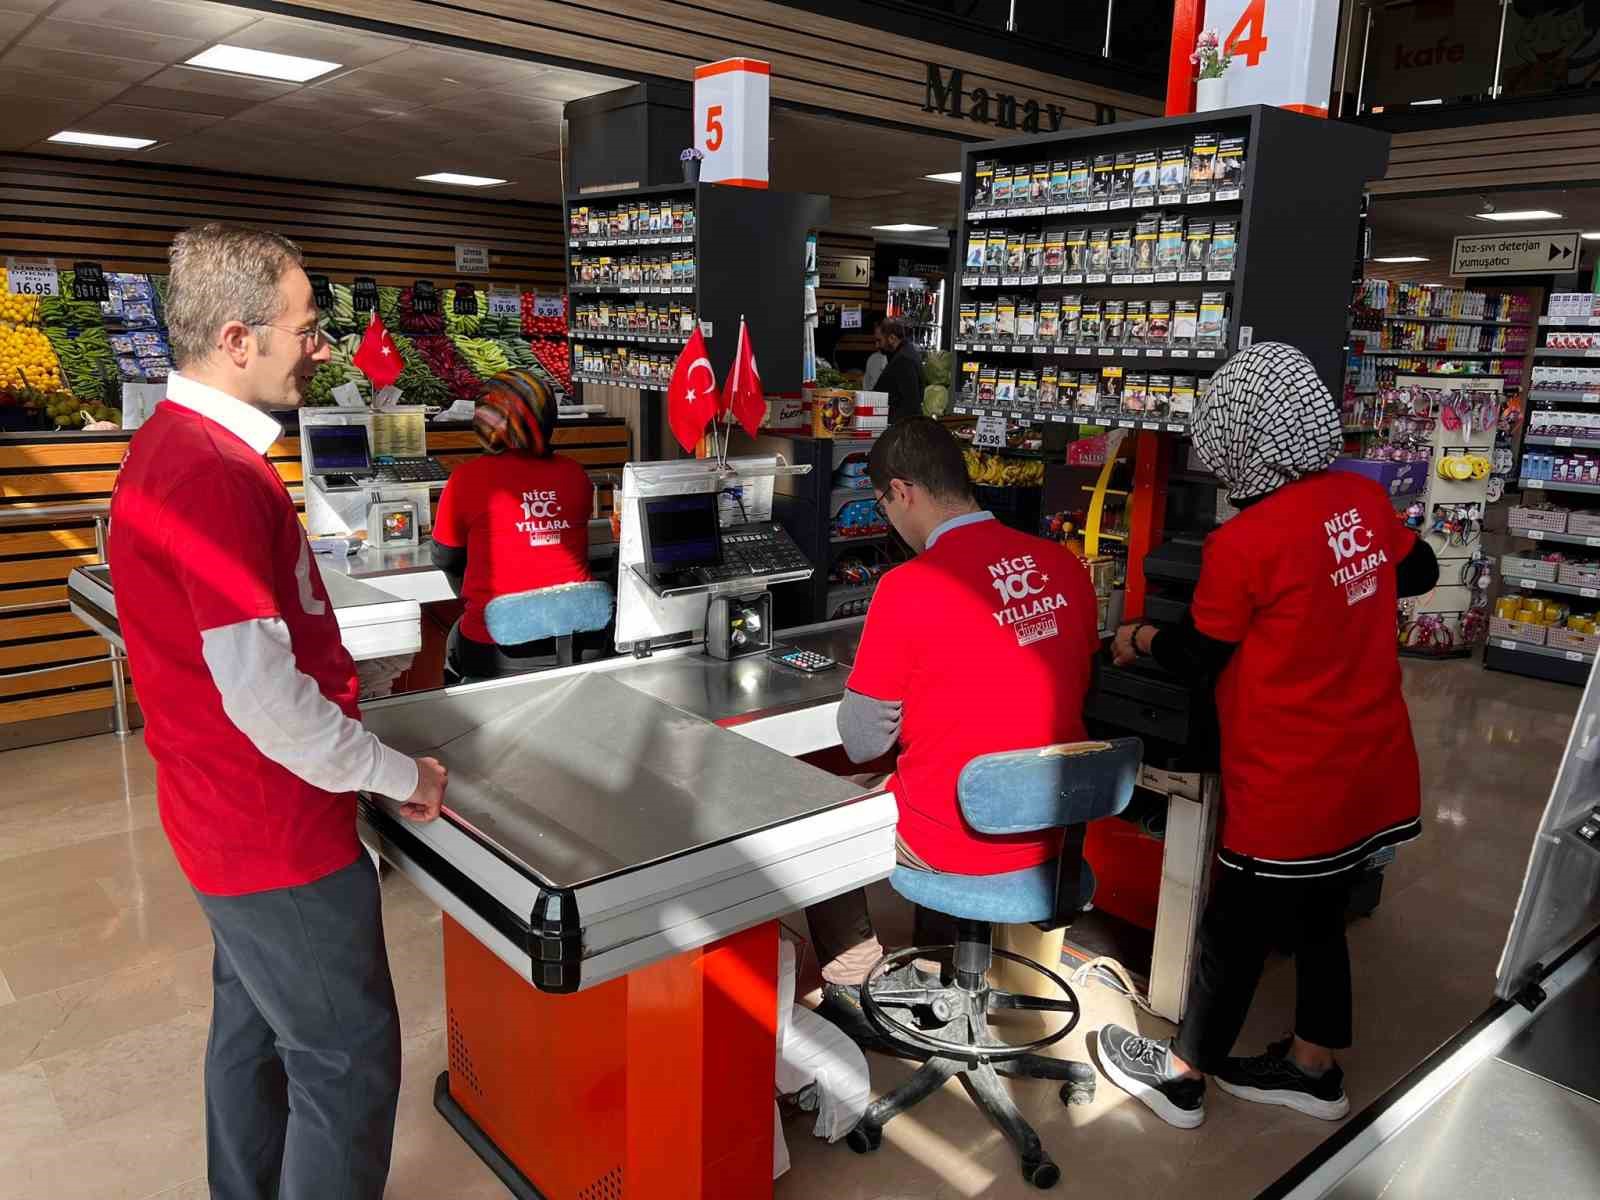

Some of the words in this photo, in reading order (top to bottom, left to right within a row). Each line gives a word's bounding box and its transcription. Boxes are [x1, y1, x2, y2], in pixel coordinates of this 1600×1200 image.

[1223, 0, 1268, 67] 4
[705, 105, 723, 151] 5
[1498, 241, 1541, 253] deterjan
[16, 282, 51, 296] 16.95
[493, 303, 516, 313] 19.95
[538, 307, 559, 316] 9.95
[978, 432, 1000, 445] 29.95
[522, 489, 557, 502] NİCE
[515, 520, 570, 533] YILLARA
[1324, 508, 1362, 537] NİCE
[988, 555, 1036, 578] NİCE
[1330, 549, 1388, 587] YILLARA
[992, 593, 1068, 627] YILLARA
